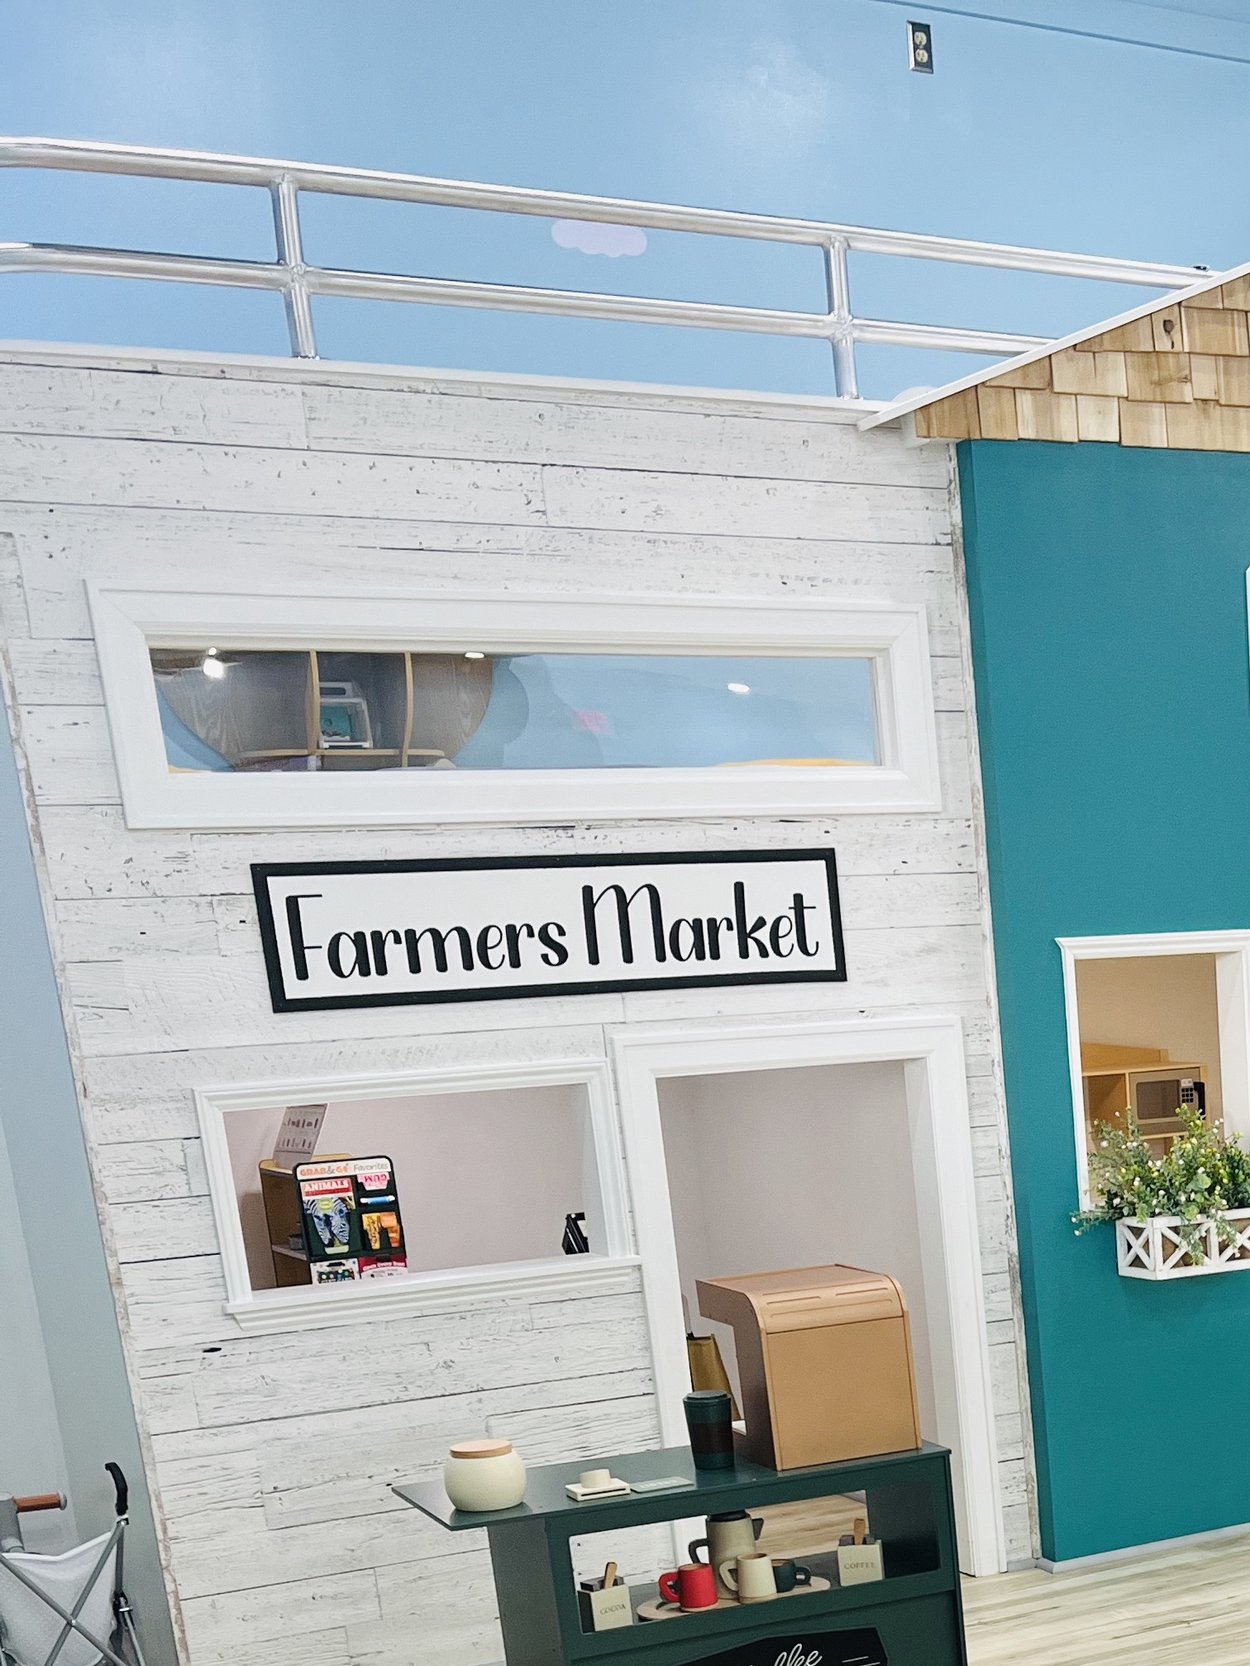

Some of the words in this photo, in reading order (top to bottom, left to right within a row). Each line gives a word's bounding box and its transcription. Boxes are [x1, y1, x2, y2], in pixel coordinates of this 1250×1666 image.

[286, 893, 569, 981] Farmers
[582, 881, 819, 965] Market
[364, 1173, 387, 1182] GUM
[304, 1180, 349, 1191] ANIMALS
